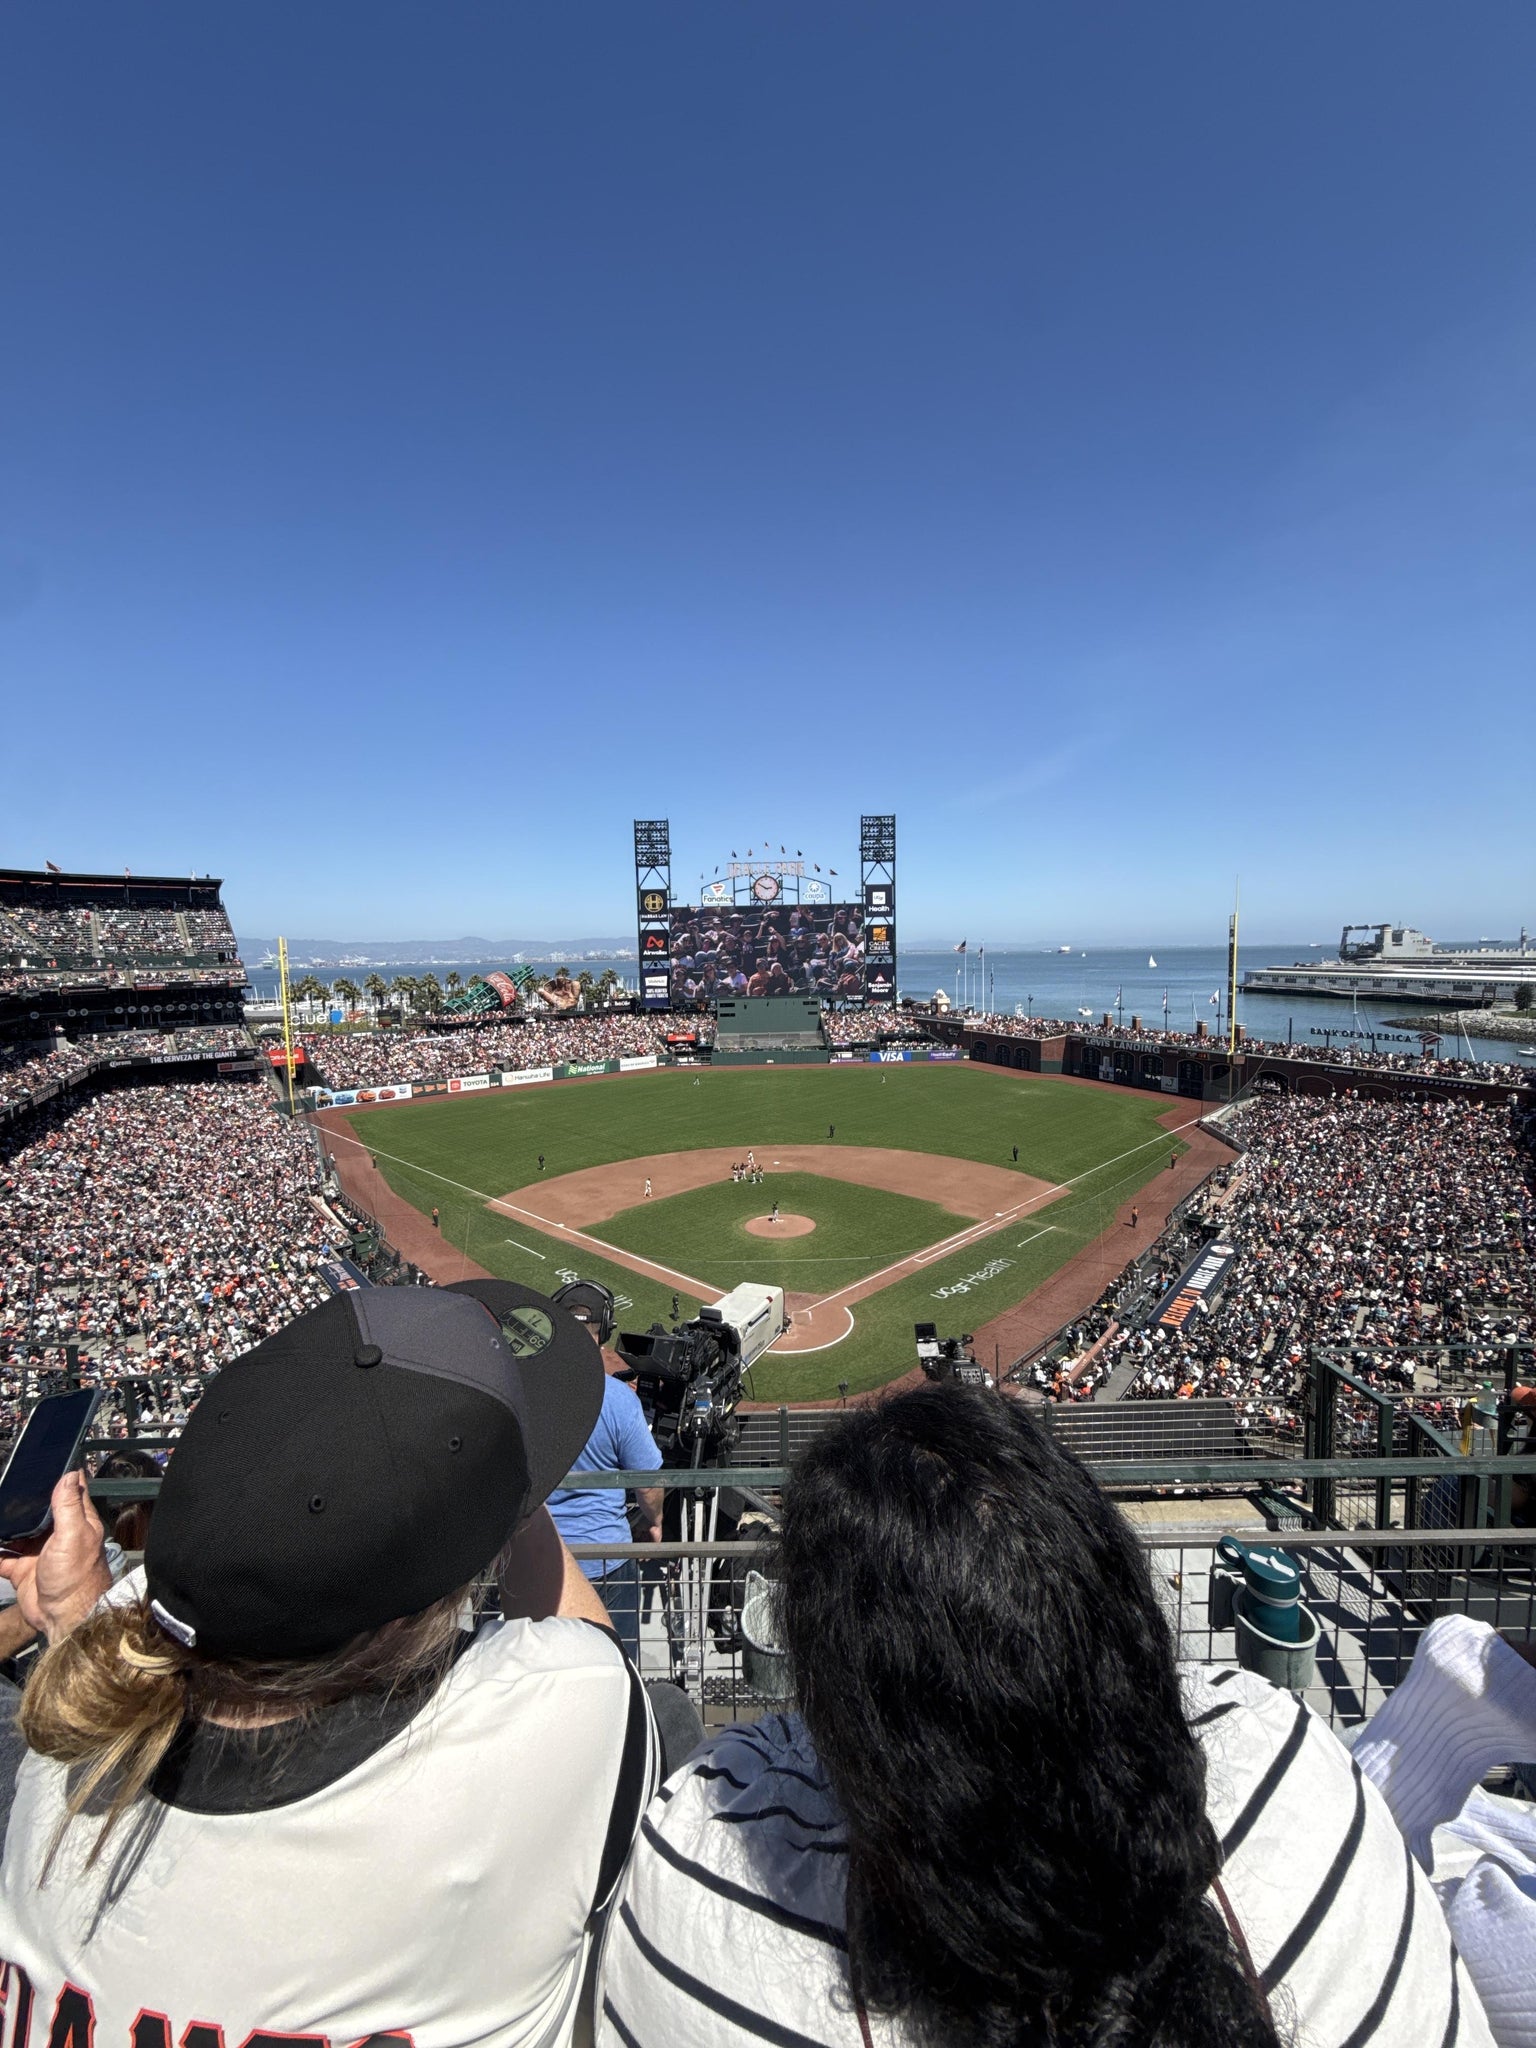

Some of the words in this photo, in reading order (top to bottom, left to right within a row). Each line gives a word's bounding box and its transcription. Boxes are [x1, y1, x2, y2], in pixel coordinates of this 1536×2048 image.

[703, 895, 734, 903] Fanatics
[804, 893, 824, 901] coupa
[1310, 1027, 1338, 1037] BANK
[1341, 1030, 1355, 1038] OF
[1356, 1031, 1412, 1043] AMERICA
[1113, 1041, 1160, 1055] LANDING
[150, 1056, 163, 1064] THE
[163, 1055, 193, 1063] CERVEZA
[214, 1050, 237, 1059] GIANTS
[879, 1052, 904, 1062] VISA
[577, 1063, 606, 1073] National
[539, 1071, 551, 1079] Life
[958, 1257, 1017, 1286] Health
